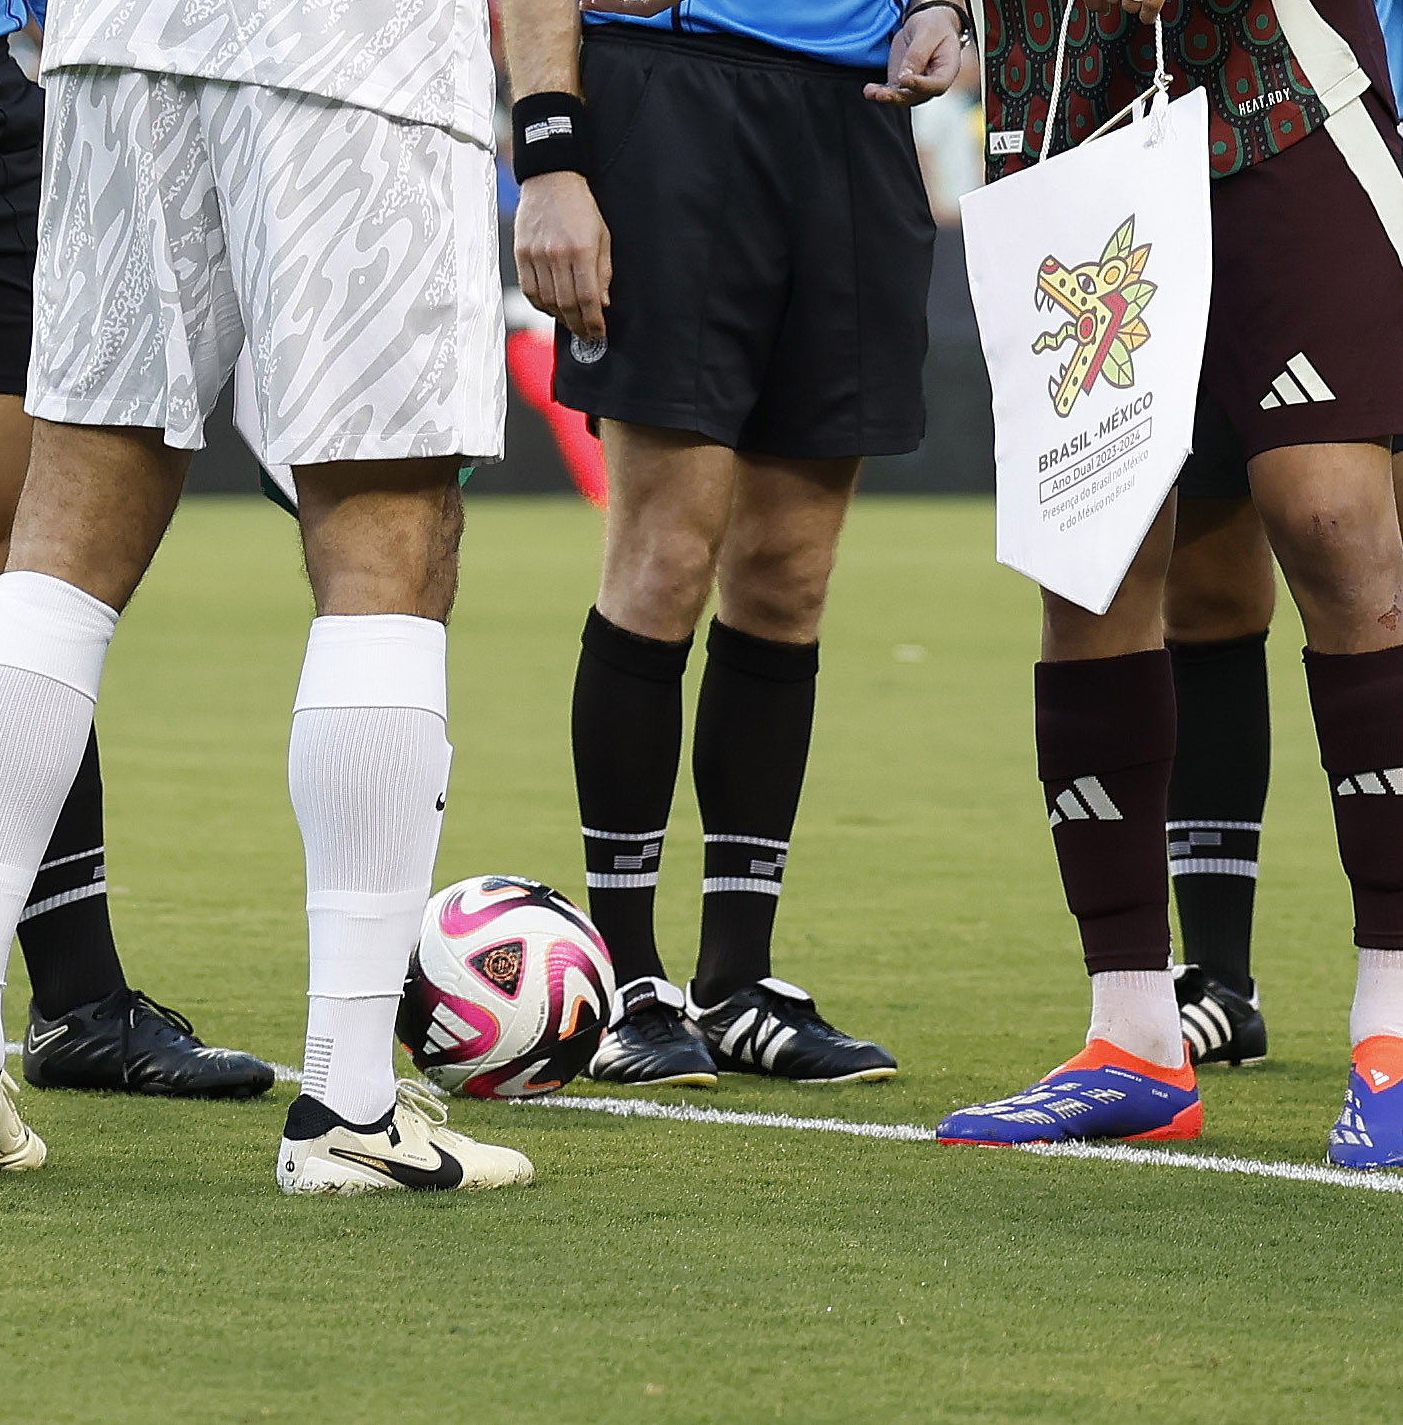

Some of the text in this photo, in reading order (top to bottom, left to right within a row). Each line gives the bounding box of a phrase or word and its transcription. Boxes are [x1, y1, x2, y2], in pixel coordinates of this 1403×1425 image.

[1238, 87, 1290, 116] HEAT.RDY
[1039, 430, 1092, 474] BRASIL
[1099, 391, 1153, 439] MÉXICO
[1051, 429, 1141, 493] Ano Dual 2023-2024
